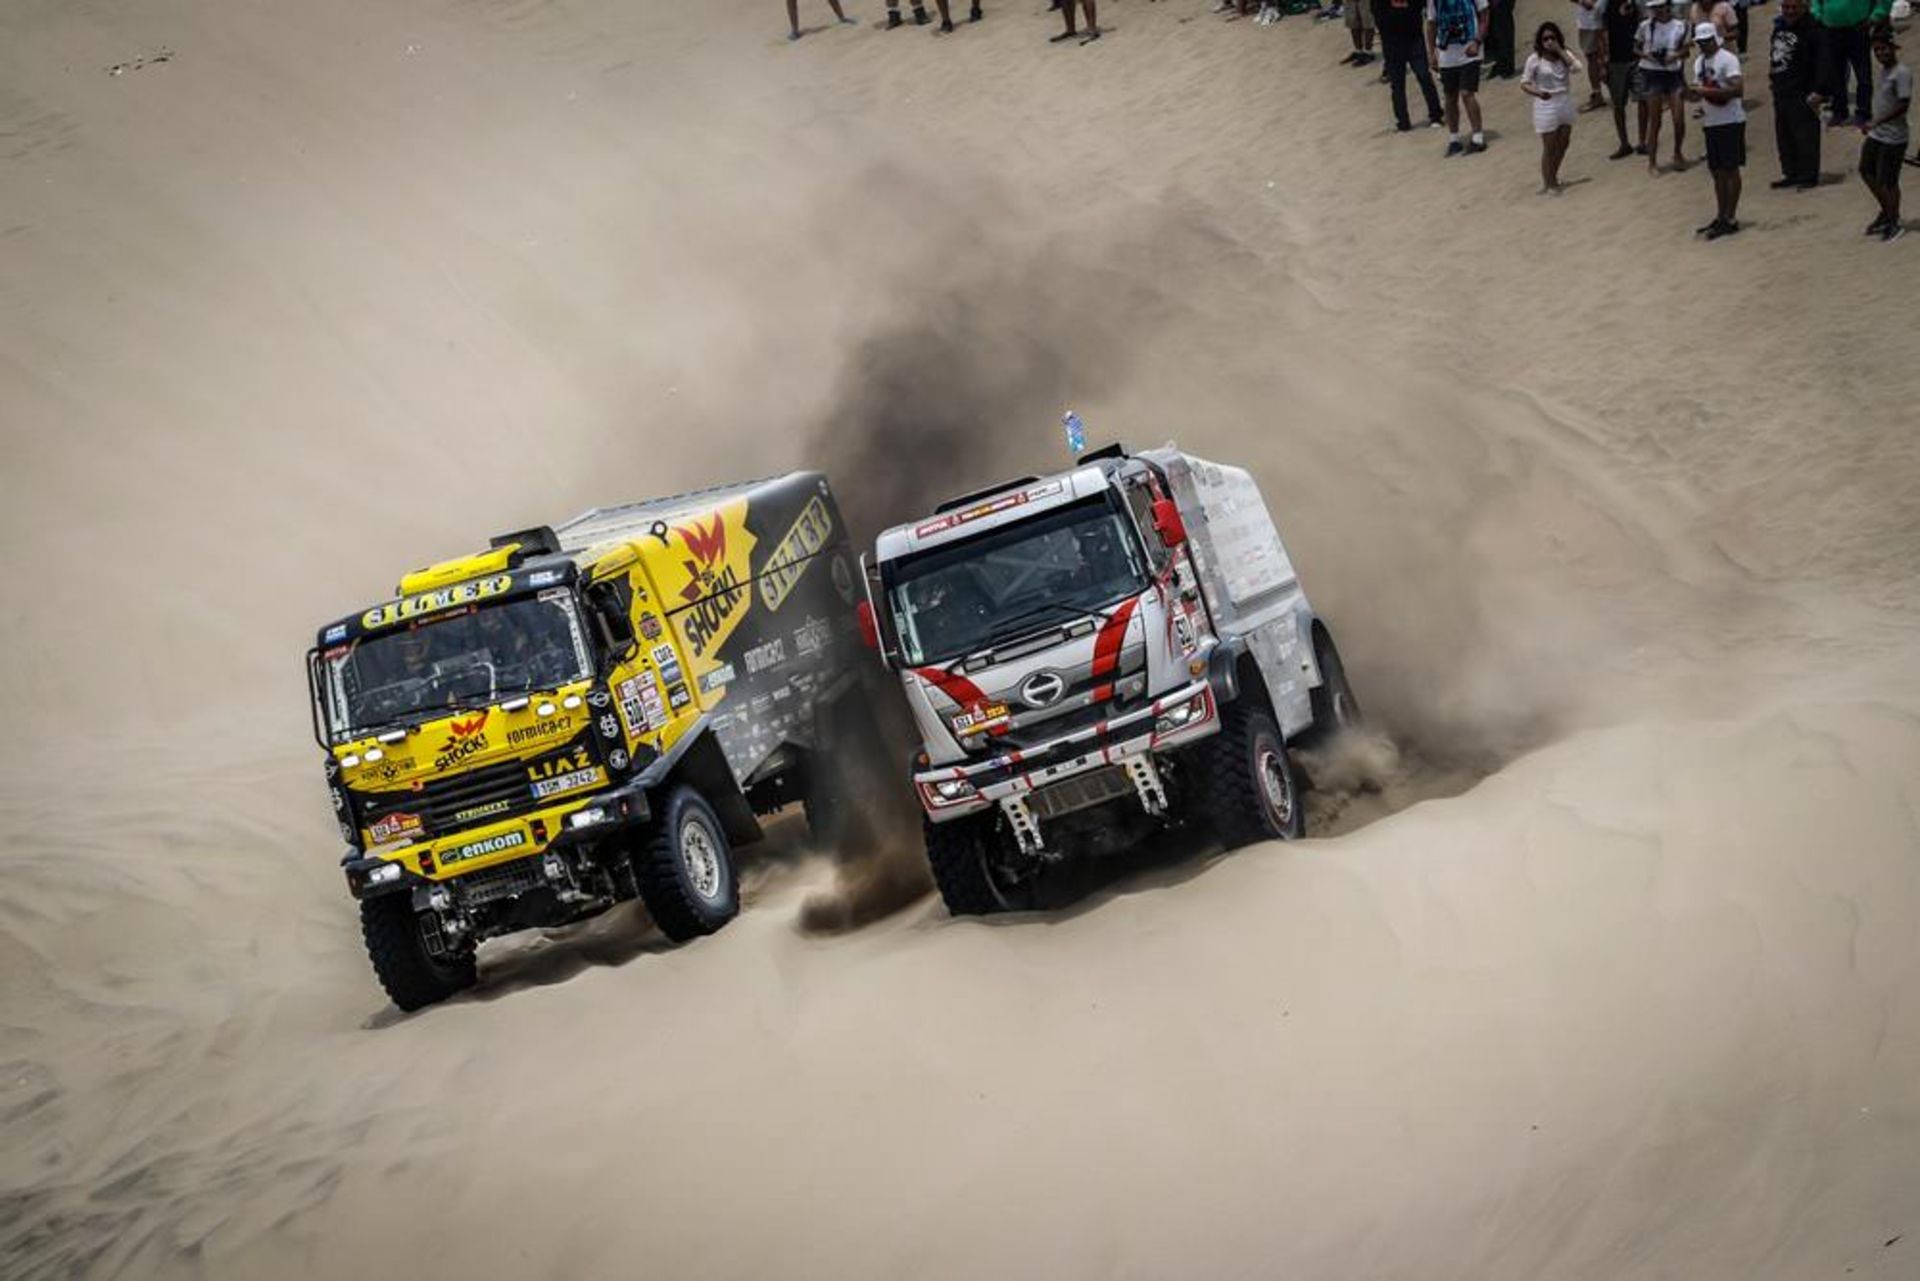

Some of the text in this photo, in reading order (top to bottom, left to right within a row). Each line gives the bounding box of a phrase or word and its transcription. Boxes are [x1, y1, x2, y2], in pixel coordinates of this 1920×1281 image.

[685, 565, 742, 657] SHOCK!
[435, 733, 486, 772] SHOCK!
[462, 831, 522, 858] enkom
